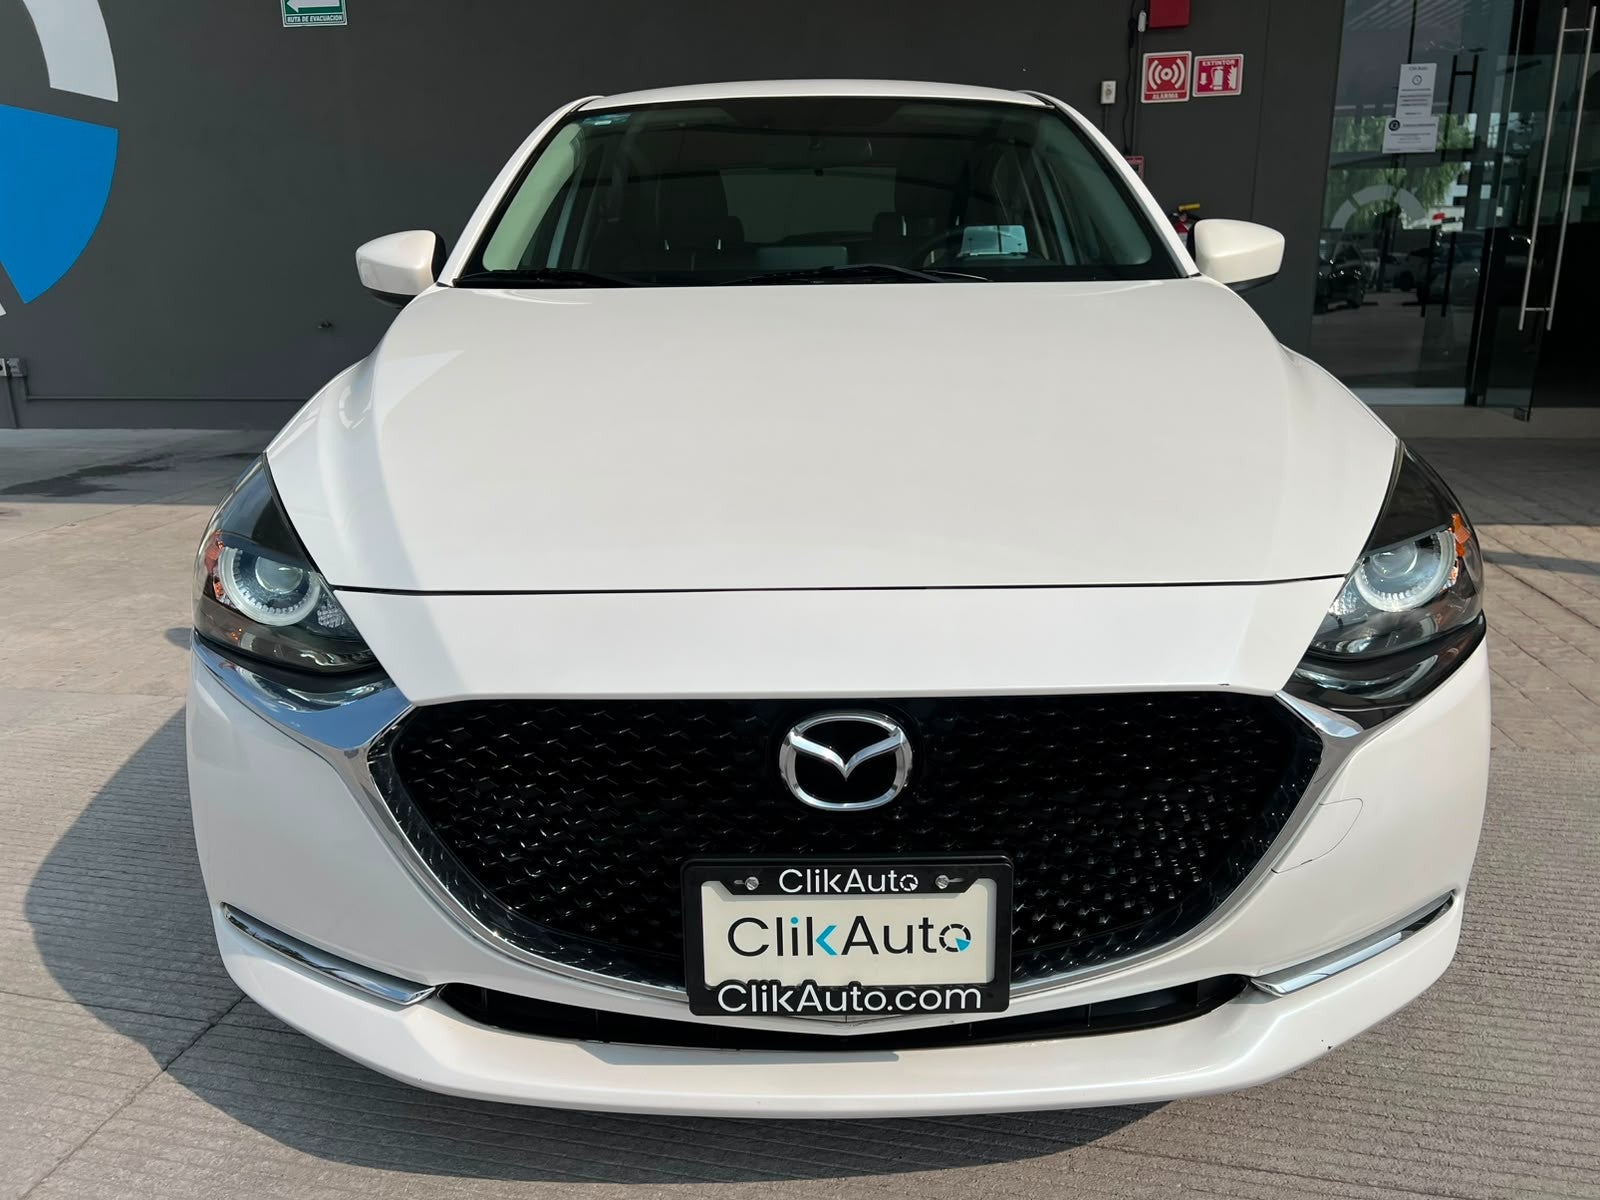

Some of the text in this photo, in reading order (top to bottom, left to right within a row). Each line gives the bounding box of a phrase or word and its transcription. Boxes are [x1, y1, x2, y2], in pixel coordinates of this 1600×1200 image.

[778, 868, 919, 893] ClikAuto
[727, 915, 972, 957] ClikAuto
[717, 983, 982, 1013] ClikAuto.com
